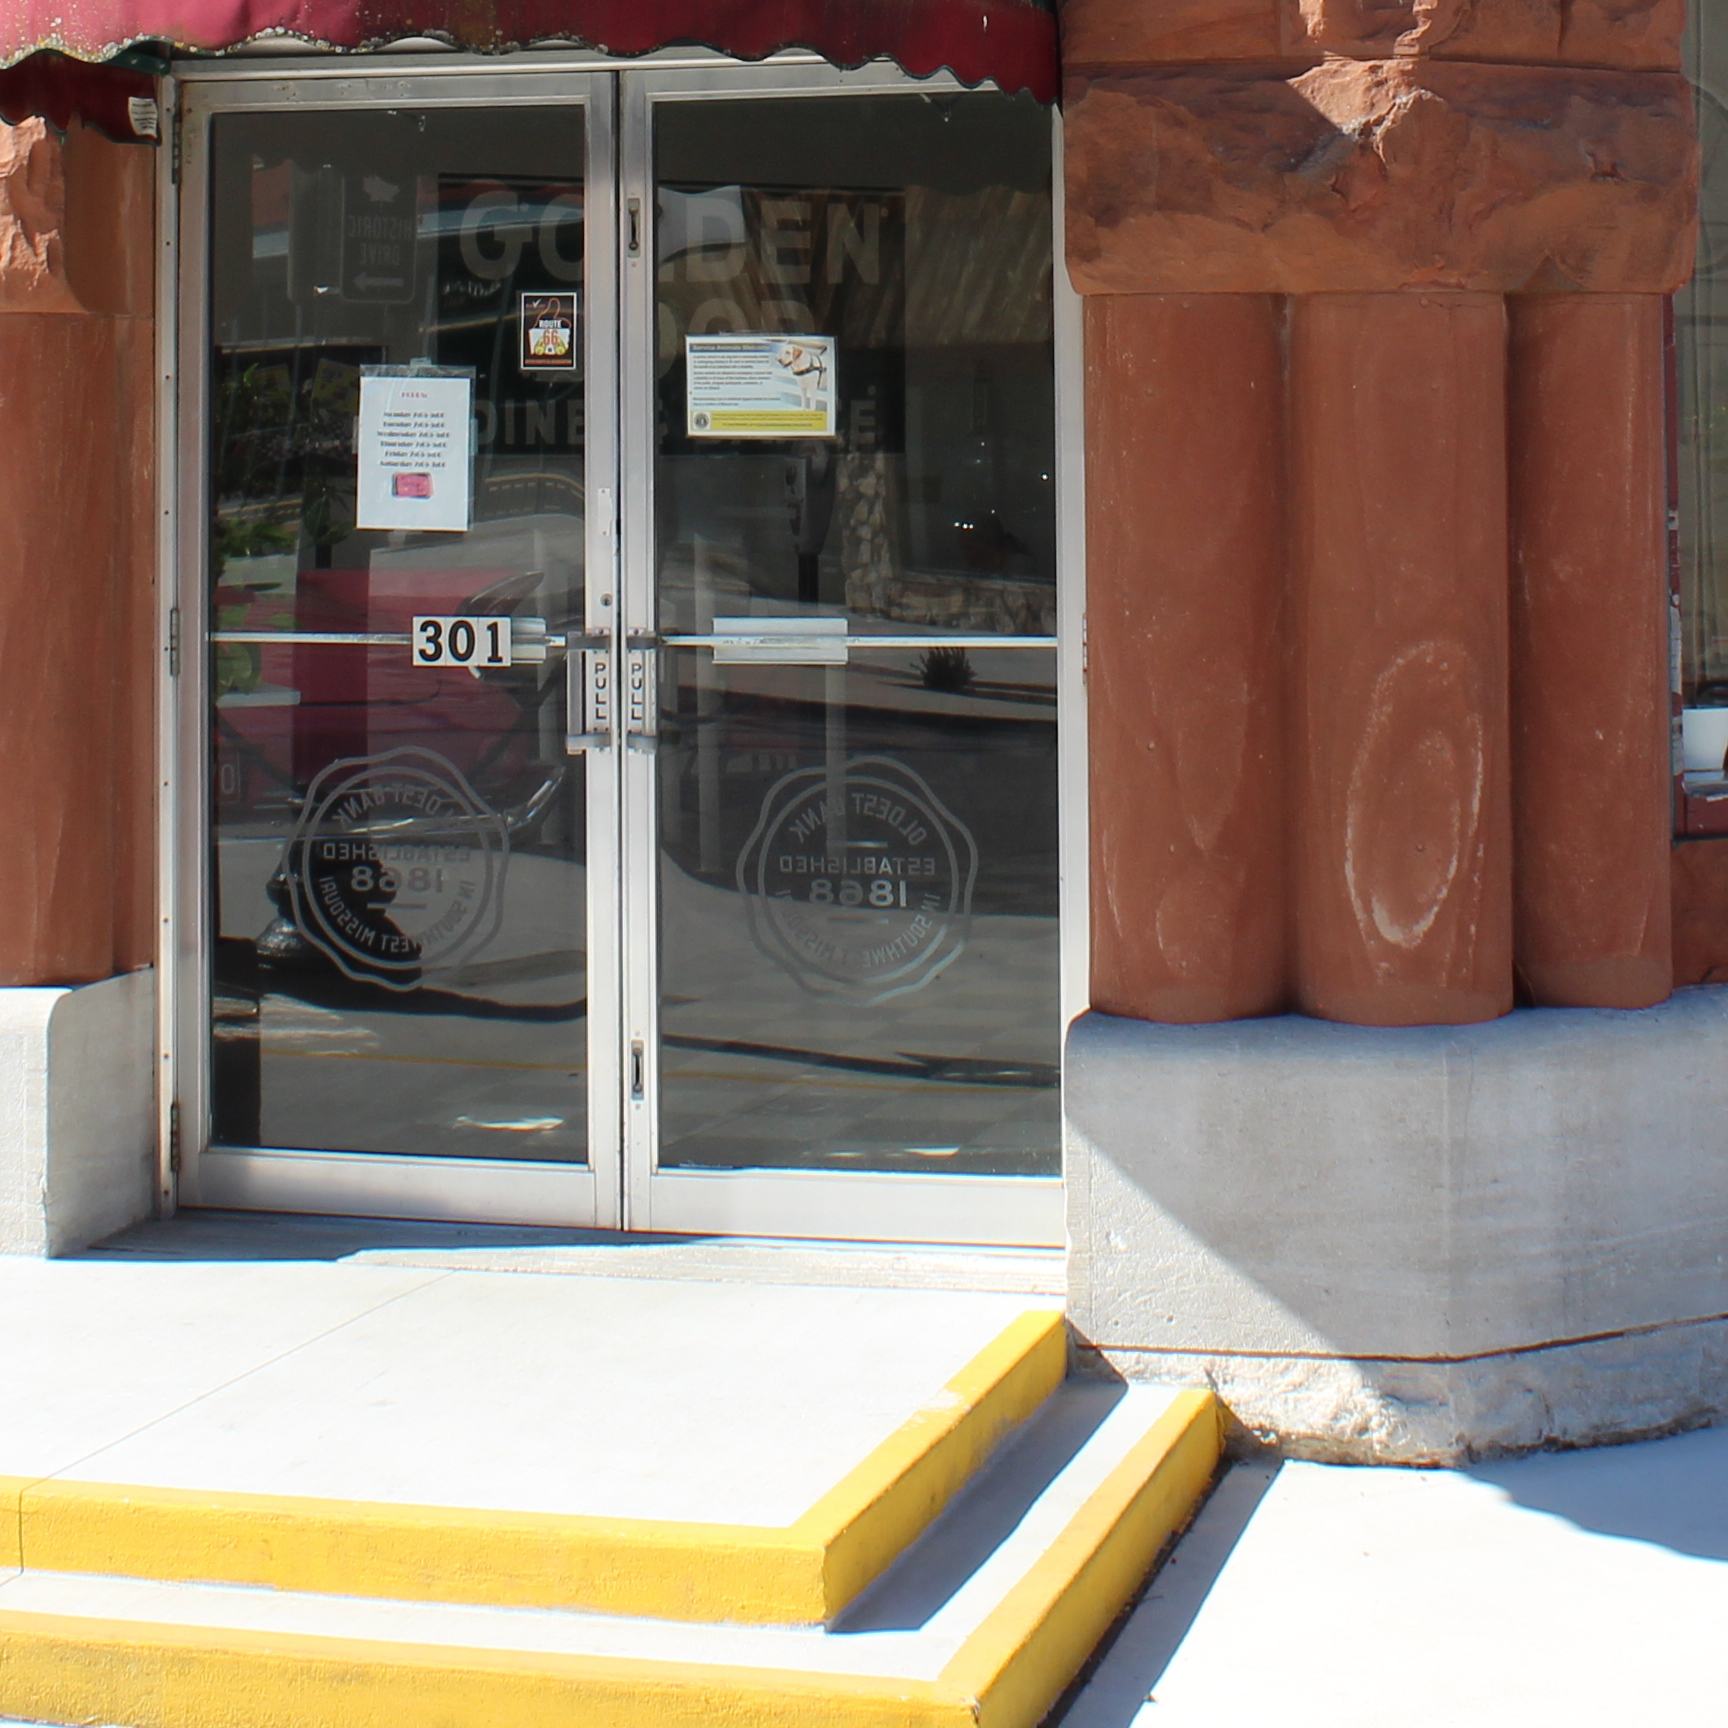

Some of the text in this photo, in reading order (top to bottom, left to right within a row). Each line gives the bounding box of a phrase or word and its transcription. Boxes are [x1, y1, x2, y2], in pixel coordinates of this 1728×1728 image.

[459, 189, 882, 285] GODEN
[538, 319, 562, 328] ROUTE
[543, 329, 558, 346] 66
[418, 619, 505, 664] 301
[594, 662, 607, 720] PULL
[631, 663, 643, 720] PULL
